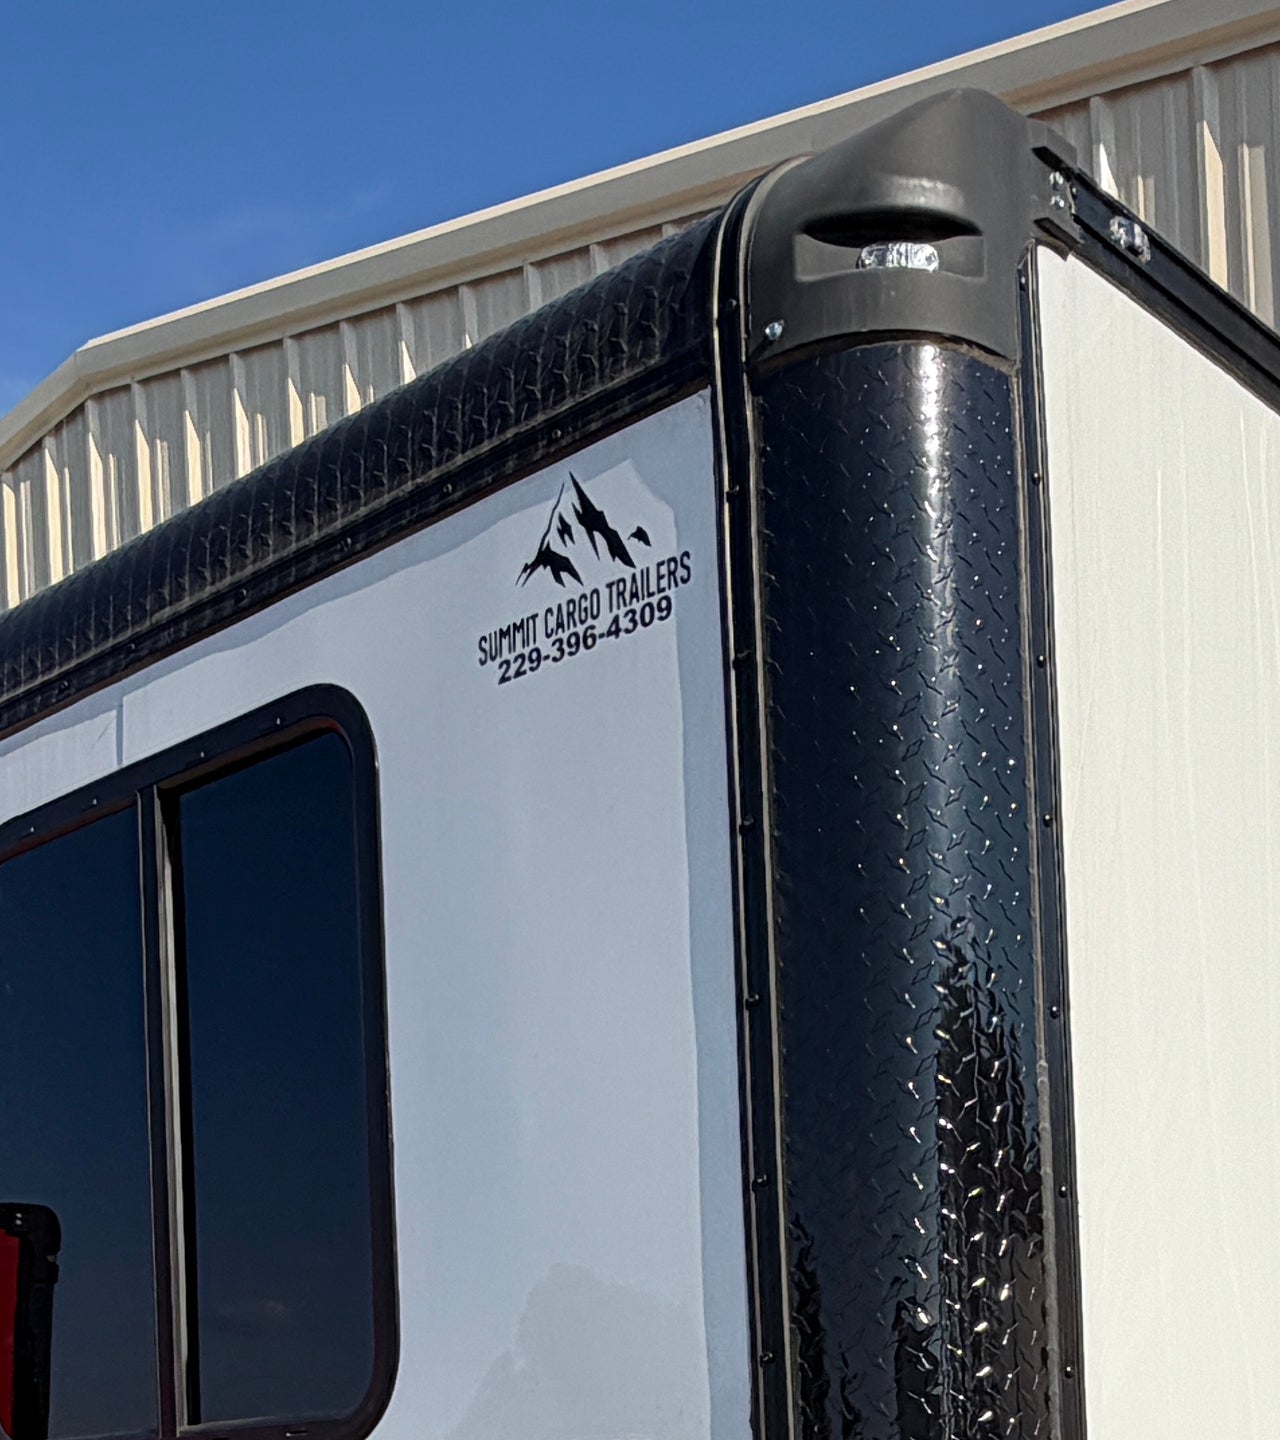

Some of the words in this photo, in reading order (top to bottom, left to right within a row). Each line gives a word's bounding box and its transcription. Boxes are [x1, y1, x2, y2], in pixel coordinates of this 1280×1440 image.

[478, 613, 538, 666] SUMMIT
[544, 588, 600, 639] CARGO
[606, 550, 692, 613] TRAILERS
[498, 595, 672, 685] 229-396-4309
